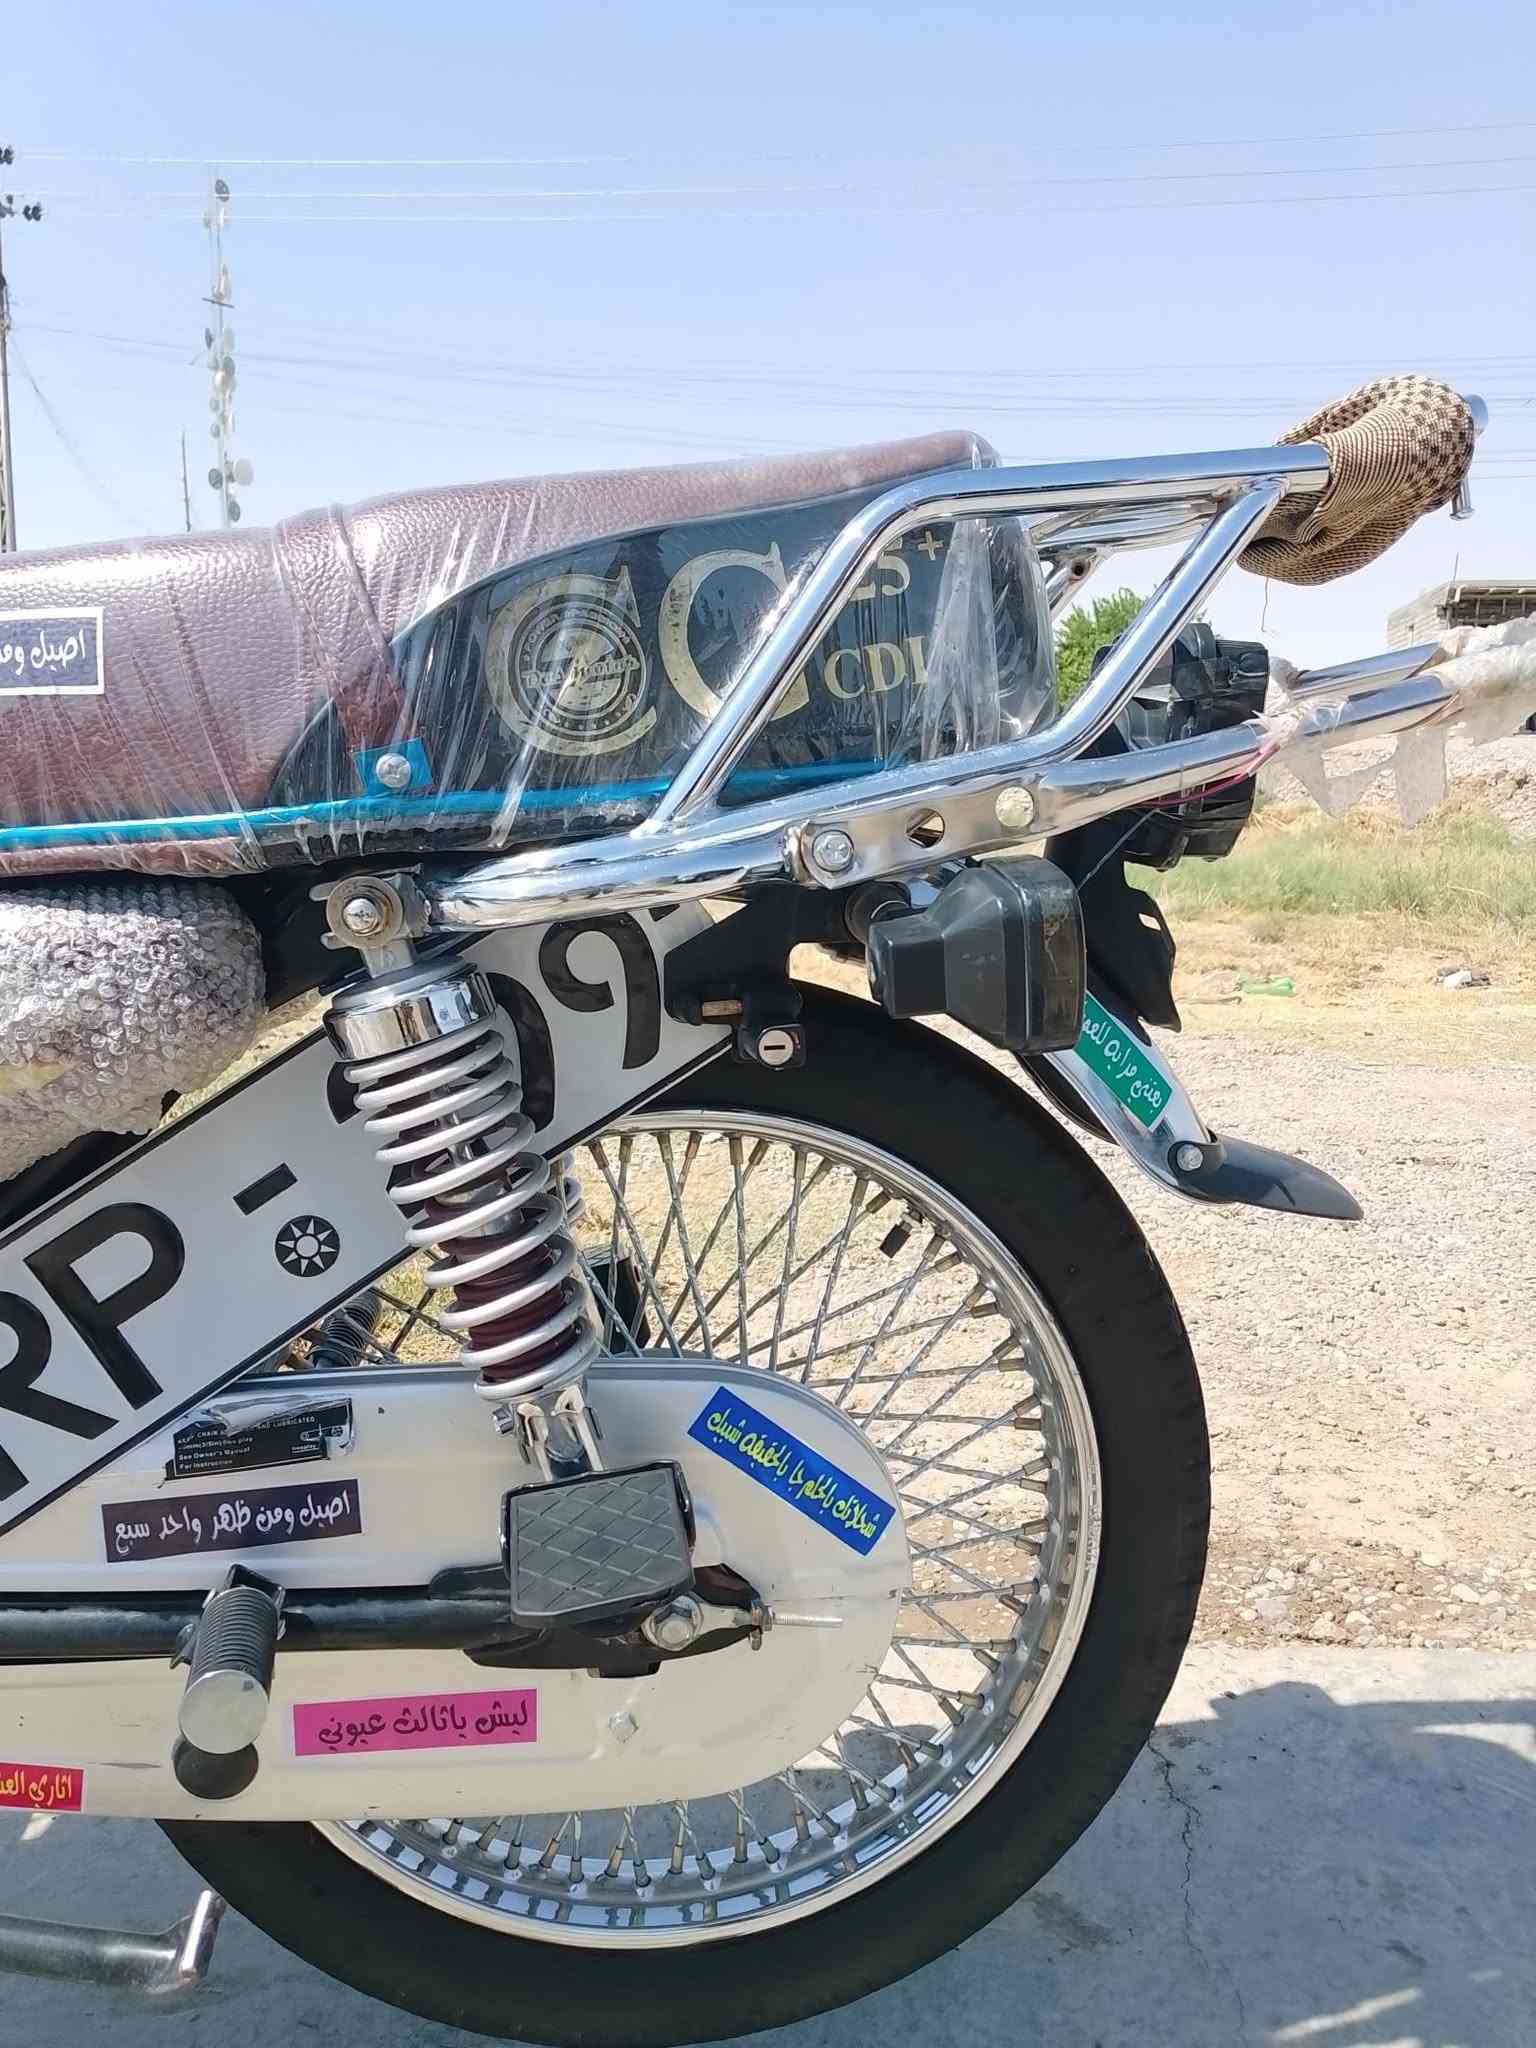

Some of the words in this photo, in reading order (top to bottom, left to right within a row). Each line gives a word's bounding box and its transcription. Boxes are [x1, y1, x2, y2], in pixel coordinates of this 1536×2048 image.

[0, 643, 25, 676] وم
[824, 635, 931, 699] CDI
[158, 1506, 202, 1544] واحد
[210, 1498, 251, 1540] ظهر
[255, 1505, 295, 1535] ومن
[299, 1488, 351, 1528] اصيل
[114, 1521, 151, 1554] سبع
[317, 1713, 387, 1753] عيوني
[474, 1699, 529, 1735] ليش
